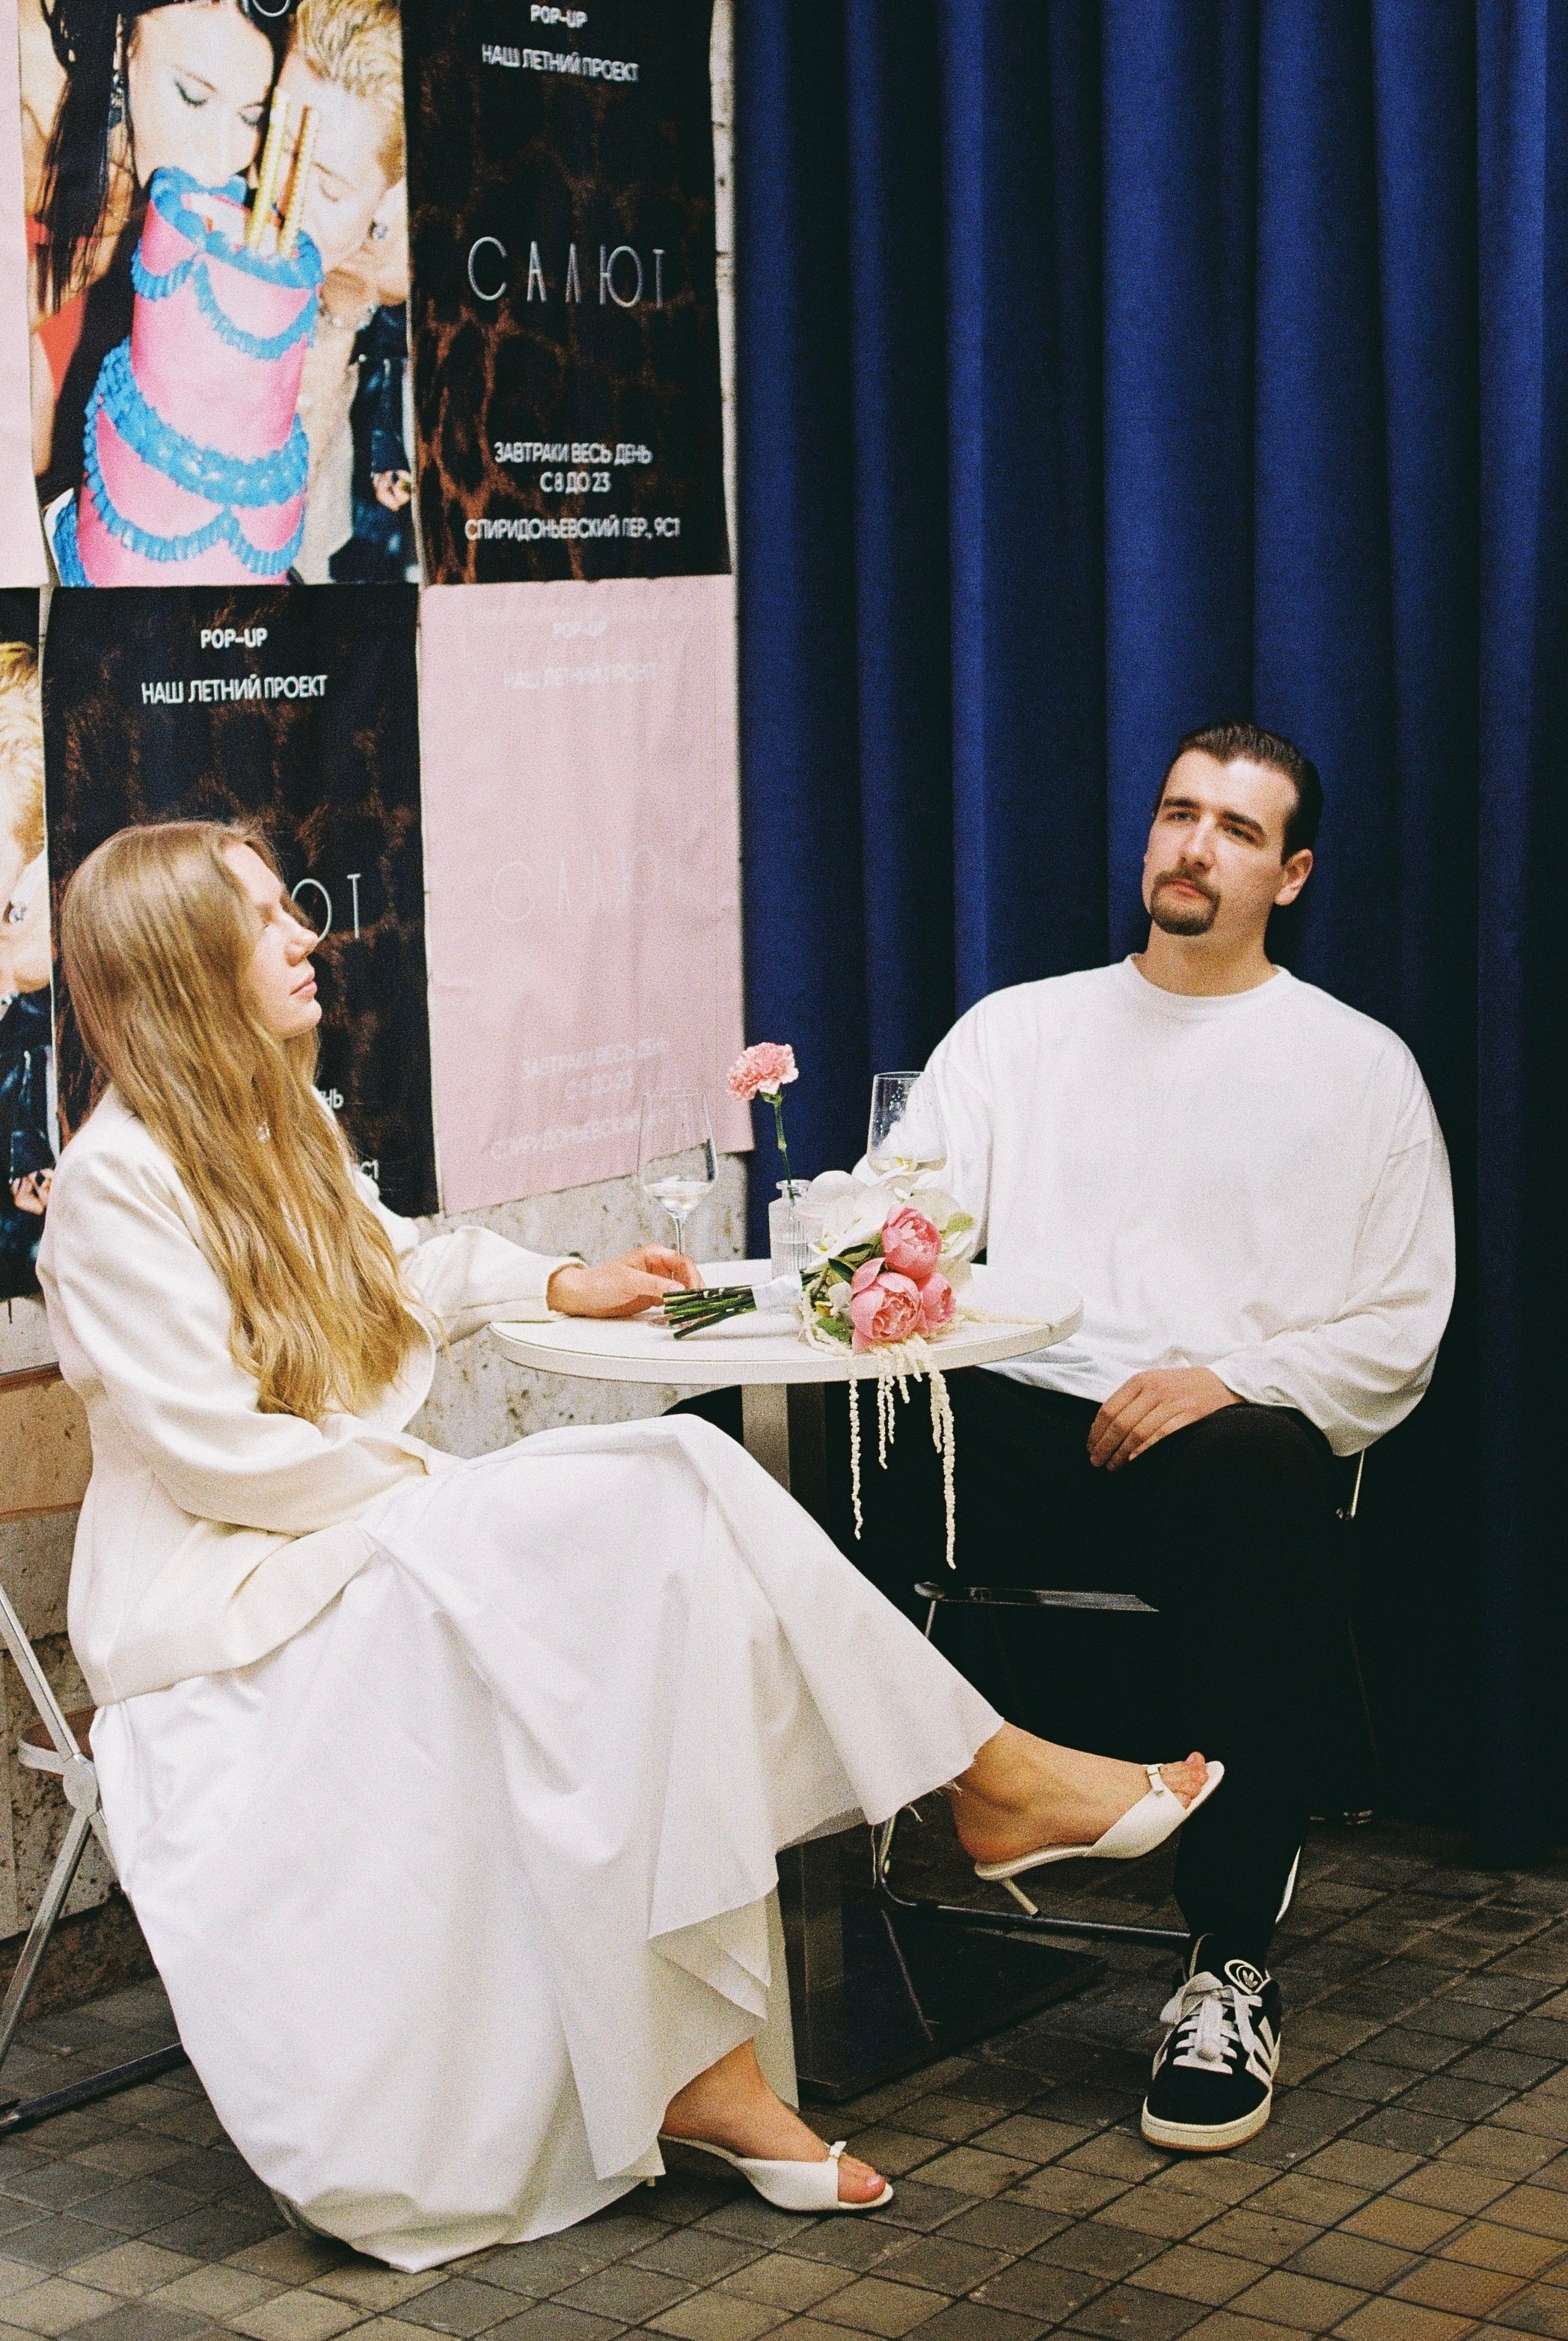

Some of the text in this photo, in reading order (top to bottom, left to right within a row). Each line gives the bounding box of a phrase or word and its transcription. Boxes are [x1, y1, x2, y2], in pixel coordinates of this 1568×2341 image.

[530, 4, 587, 28] POP-UP
[482, 43, 639, 82] НАШ ЛЕТНИЙ ПРОЕКТ
[468, 236, 665, 308] САЛЮТ
[494, 441, 653, 466] ЗАВТРАКИ ВЕСЬ ДЕНЬ
[539, 471, 611, 494] С 8 ДО 23
[465, 514, 620, 542] СПИРИДОНЬЕВСКИЙ
[200, 627, 268, 649] POP-UP
[141, 673, 328, 705] НАШ ЛЕТНИЙ ПРОЕКТ
